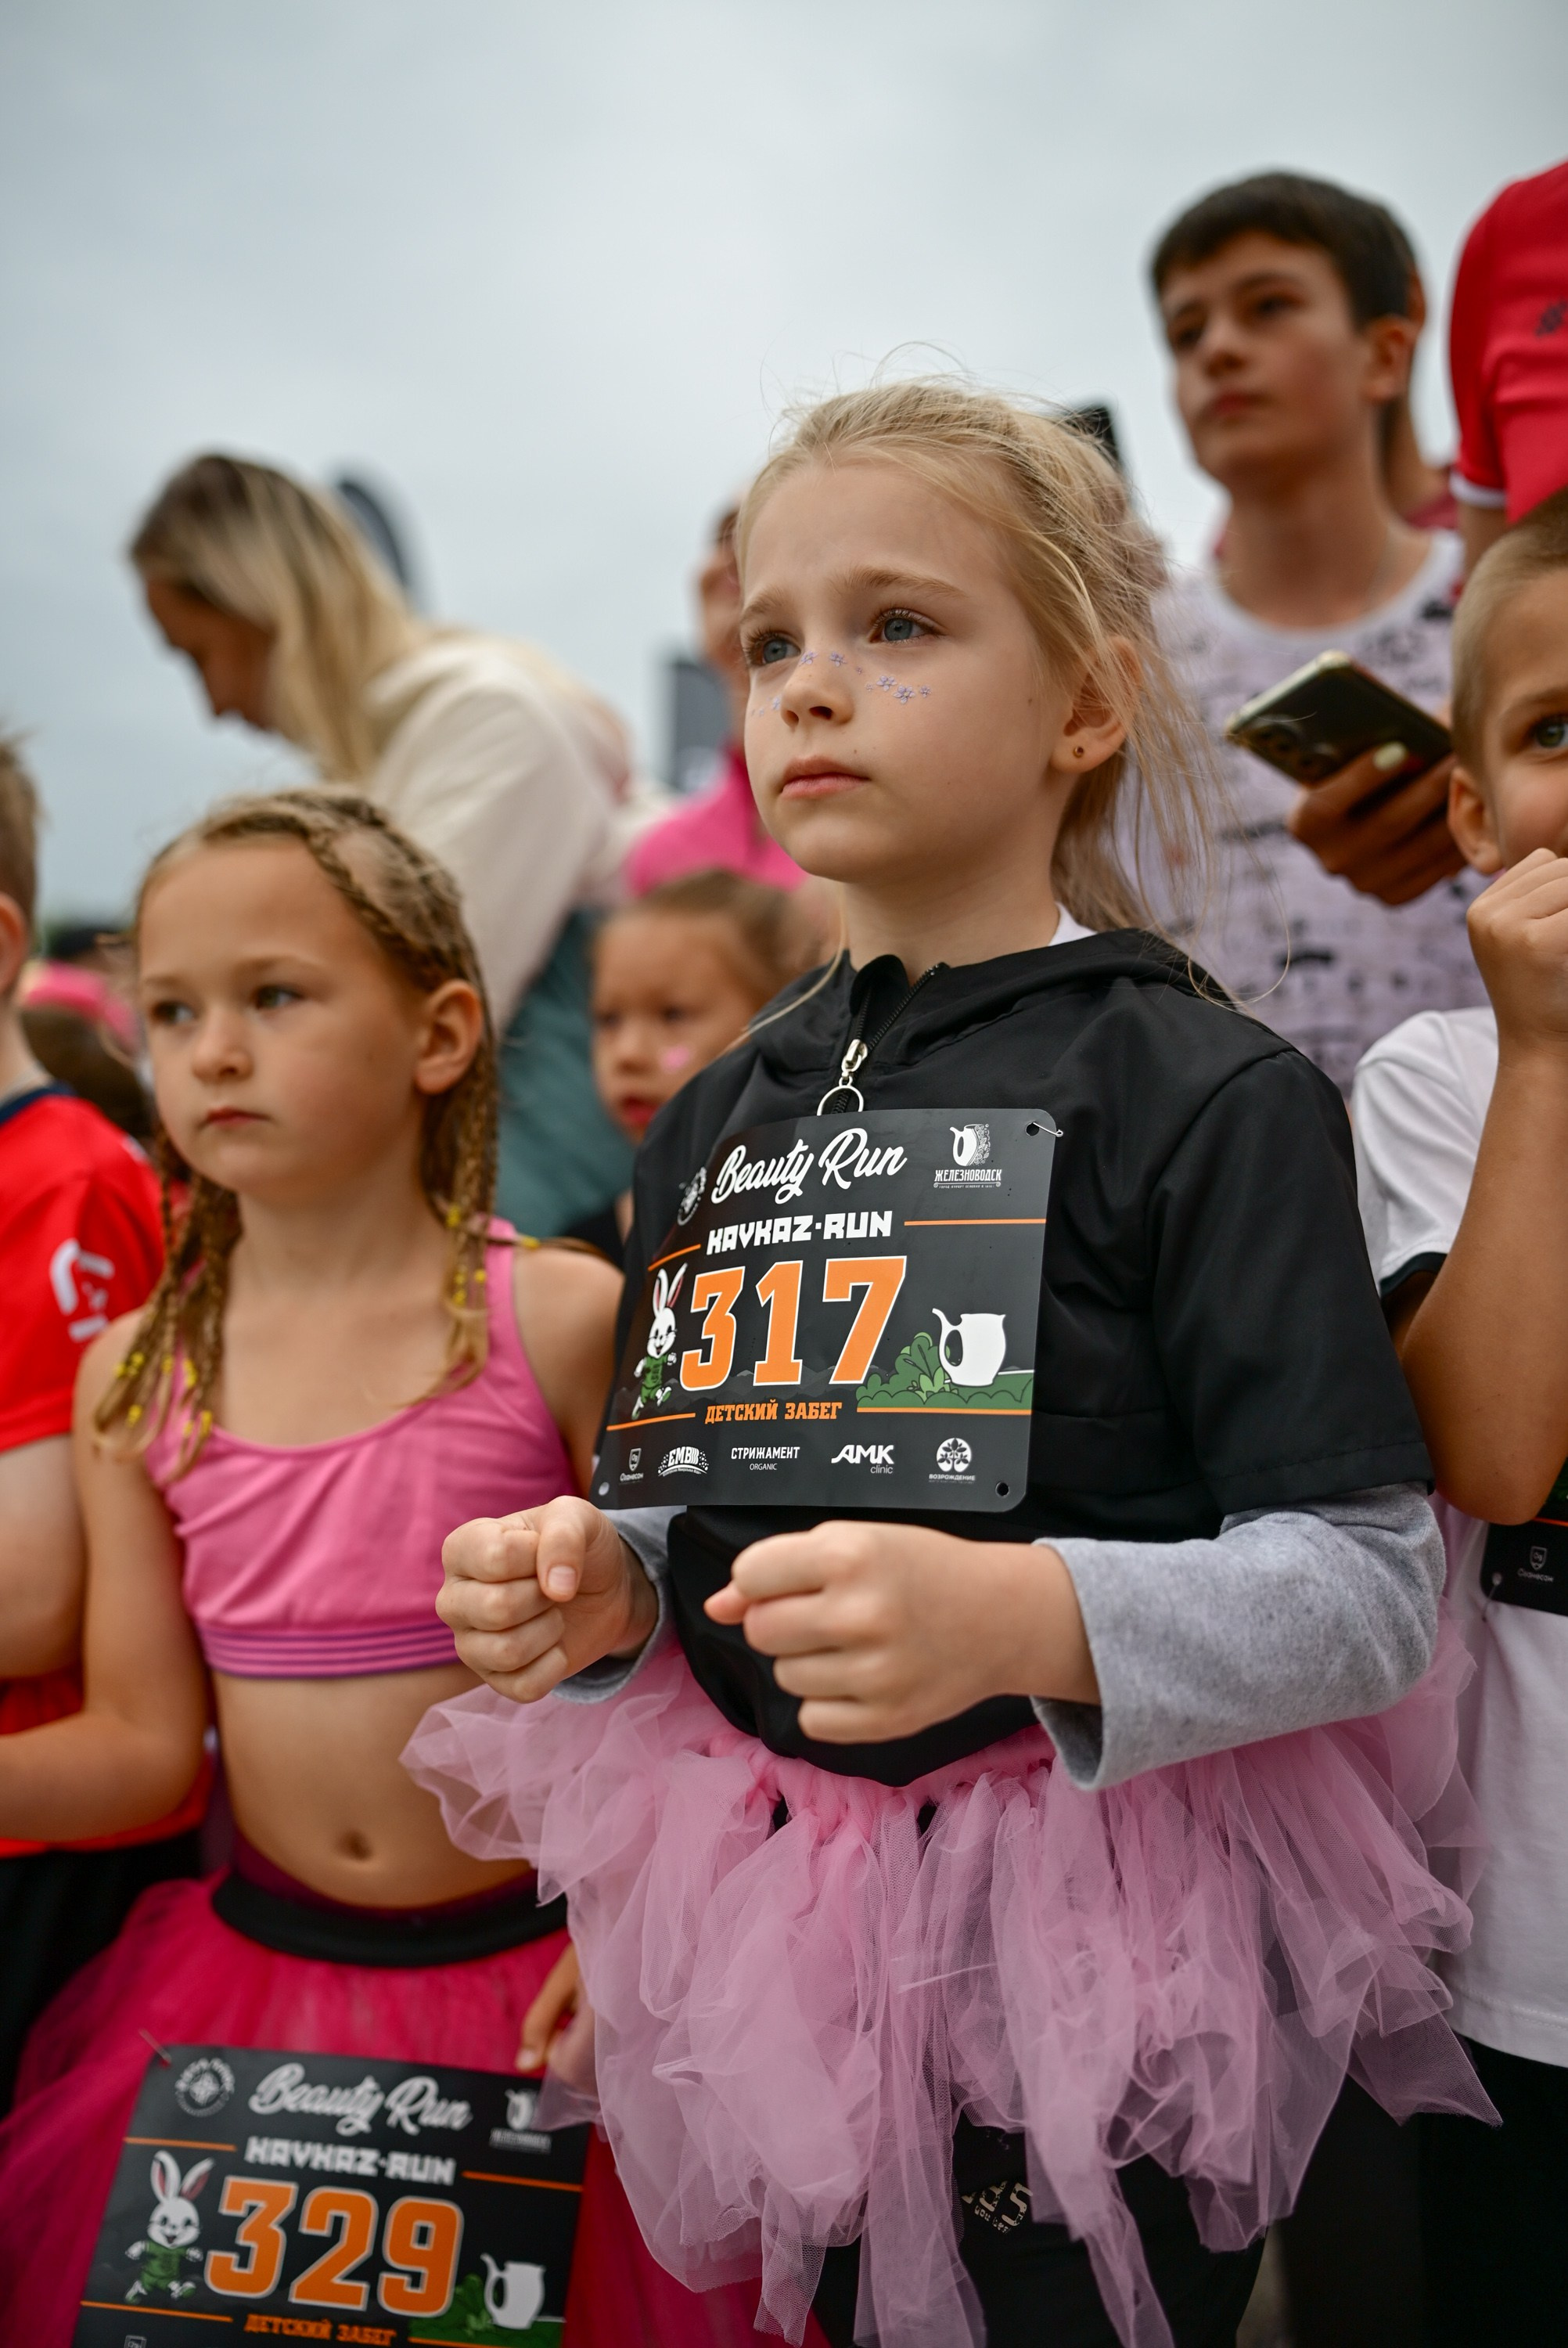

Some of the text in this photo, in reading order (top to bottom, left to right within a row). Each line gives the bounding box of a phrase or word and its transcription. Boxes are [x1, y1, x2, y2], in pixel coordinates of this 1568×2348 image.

[710, 1139, 815, 1205] Beauty
[818, 1128, 908, 1190] Run
[934, 1169, 1002, 1182] ЖЕЛЕЗНОВОДСК
[679, 1255, 908, 1392] 317
[704, 1399, 842, 1424] ДЕТСКИЙ ЗАБЕГ
[731, 1446, 800, 1459] СТРИЖАМЕНТ
[870, 1465, 893, 1474] clinic
[248, 2062, 386, 2137] Beauty
[383, 2076, 473, 2135] Run
[204, 2176, 465, 2318] 329
[243, 2313, 397, 2346] ДЕТСКИЙ ЗАБЕГ
